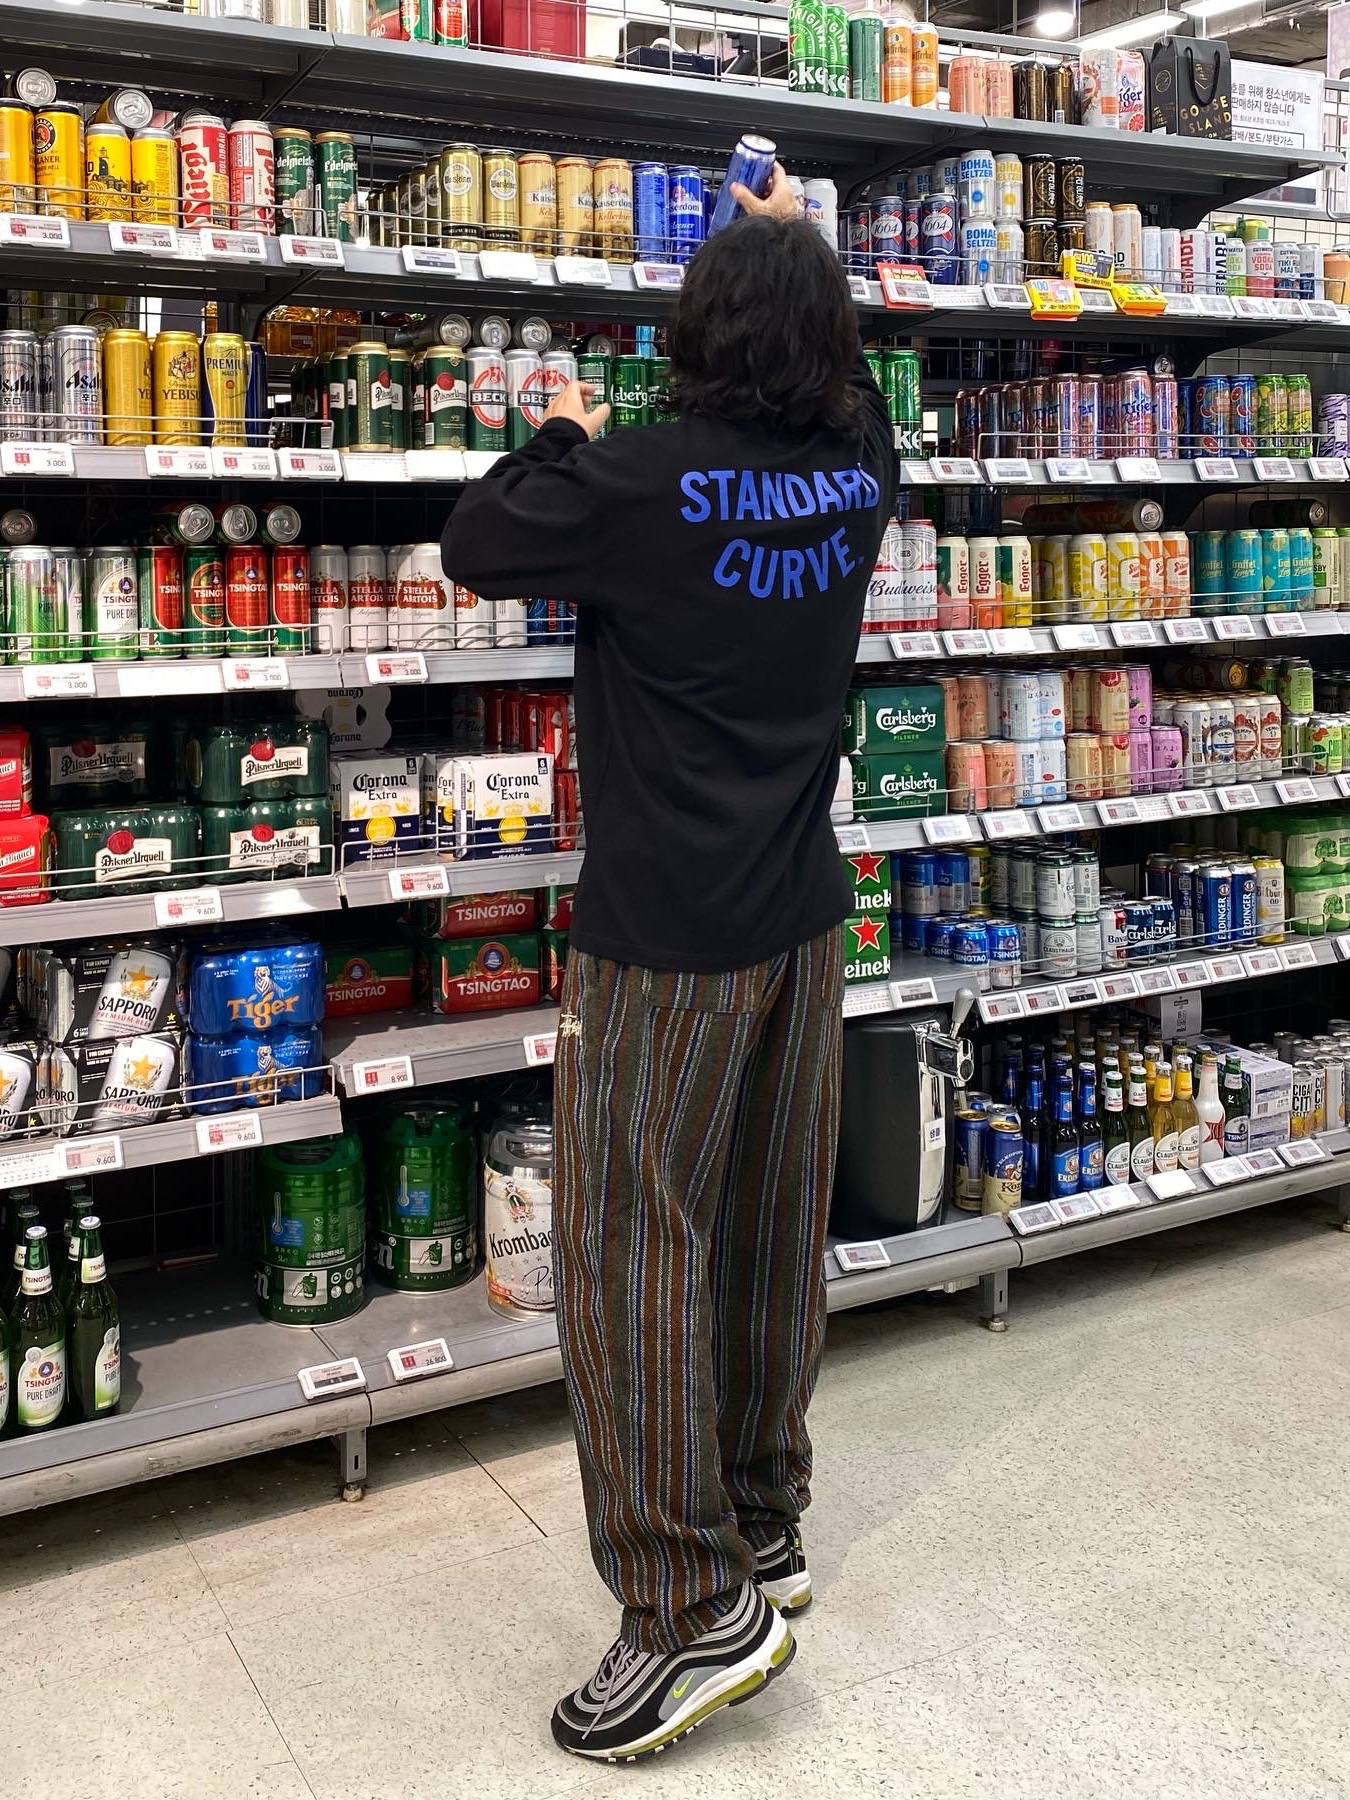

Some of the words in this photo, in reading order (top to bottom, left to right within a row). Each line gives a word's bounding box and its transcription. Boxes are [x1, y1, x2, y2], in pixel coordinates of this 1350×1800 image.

[788, 61, 828, 89] eke
[1119, 87, 1143, 106] iger
[1264, 100, 1295, 116] 않습니다
[1188, 111, 1232, 134] SLAND
[961, 158, 993, 170] BOHAE
[961, 168, 993, 180] SELTZER
[670, 202, 700, 213] serdom
[966, 228, 997, 239] BOHAE
[0, 374, 35, 394] sahi
[65, 370, 101, 390] Asa
[471, 392, 507, 402] BECK
[679, 462, 881, 523] STANDARD
[957, 559, 969, 594] Egger
[976, 560, 990, 594] Egger
[1019, 559, 1030, 593] Egger
[103, 595, 137, 604] TSINGT
[193, 589, 224, 598] TSINGT
[351, 585, 383, 594] STELLA
[351, 594, 383, 603] ARTOIS
[106, 609, 125, 619] PURE
[876, 706, 937, 734] Carlsberg
[61, 756, 99, 776] Pilsner
[99, 752, 134, 767] Urquell
[245, 760, 275, 777] Pilsner
[275, 757, 302, 770] Urquell
[353, 773, 408, 792] Corona
[486, 773, 539, 792] Corona
[880, 772, 938, 800] Carlsberg
[368, 789, 397, 801] Extra
[501, 789, 530, 801] Extra
[101, 855, 134, 875] Pilsner
[134, 851, 164, 866] Urquell
[854, 888, 892, 911] inek
[1257, 886, 1282, 899] Bitbur
[456, 903, 527, 921] TSINGTAO
[1217, 897, 1226, 940] ERDINGER
[1243, 892, 1252, 936] ERDINGER
[845, 956, 891, 980] einek
[328, 985, 386, 1002] TSINGTAO
[457, 976, 531, 996] TSINGTAO
[98, 995, 157, 1021] SAPPORO
[226, 991, 300, 1030] Tiger
[231, 1067, 300, 1107] Tiger
[101, 1085, 163, 1110] SAPPORO
[25, 1371, 63, 1388] TSINGTAO
[27, 1389, 43, 1401] PURE
[45, 1383, 62, 1399] DRAFT
